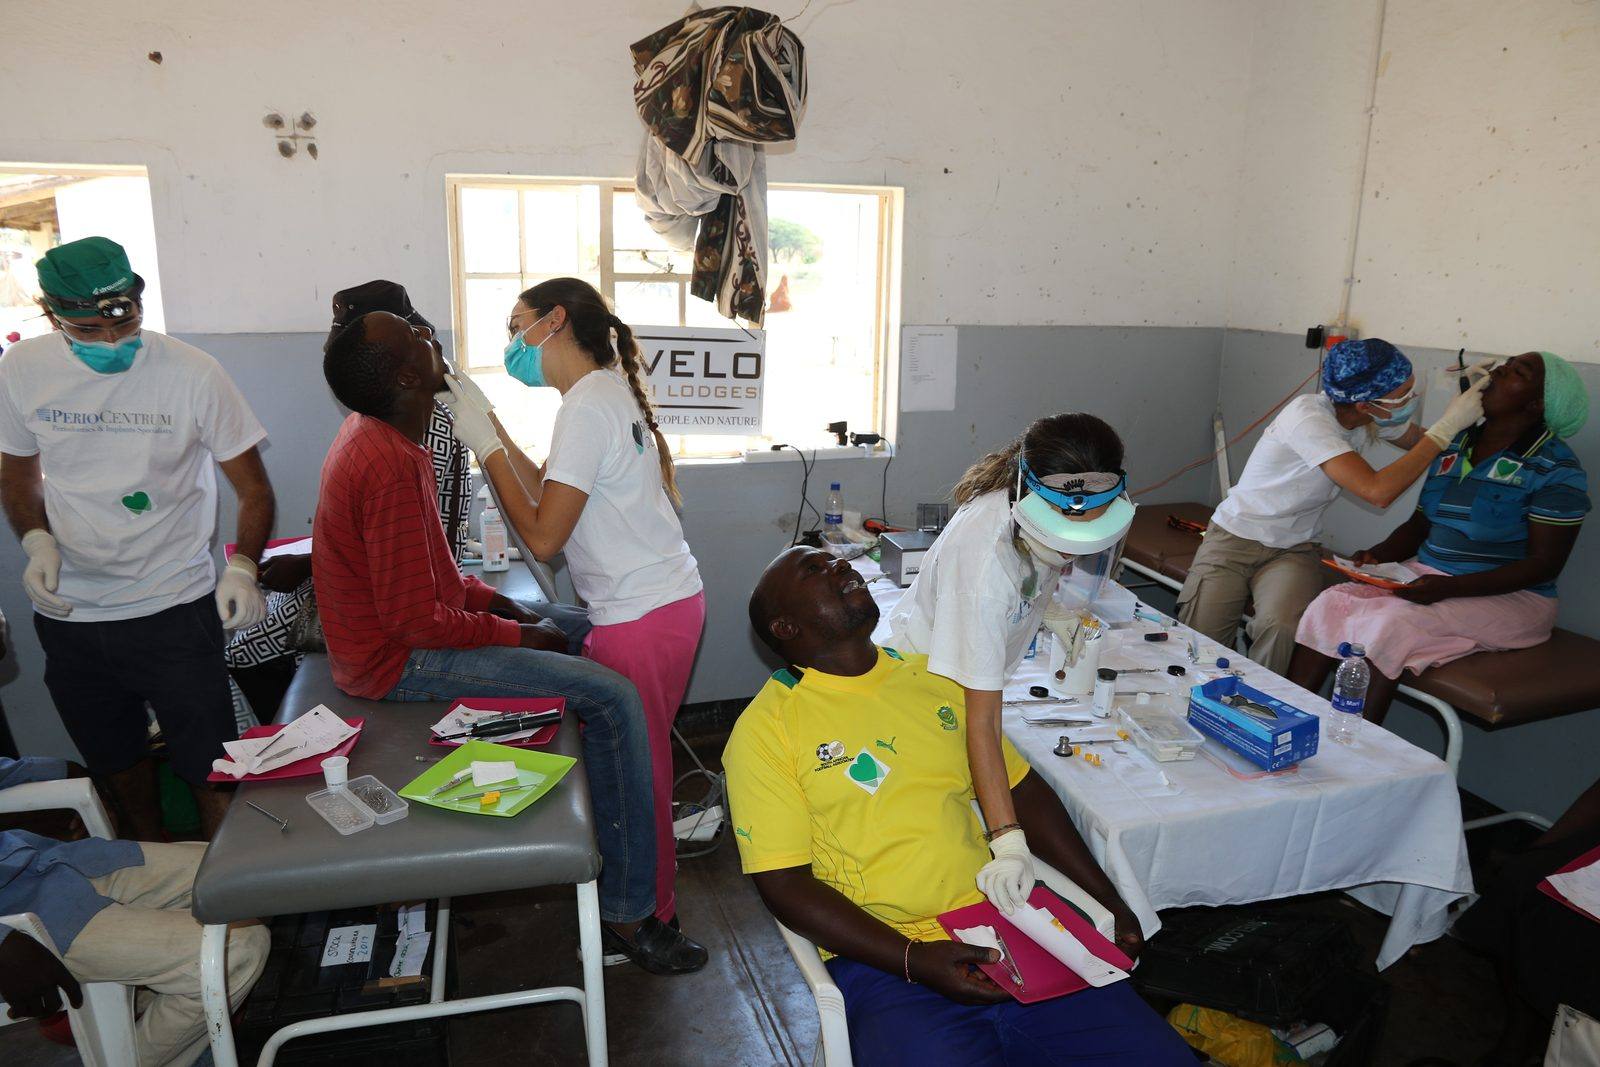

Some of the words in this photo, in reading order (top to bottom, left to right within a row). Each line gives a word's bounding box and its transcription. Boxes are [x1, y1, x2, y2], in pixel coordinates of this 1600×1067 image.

[667, 384, 758, 399] LODGES
[691, 416, 715, 425] AND
[718, 416, 757, 426] NATURE
